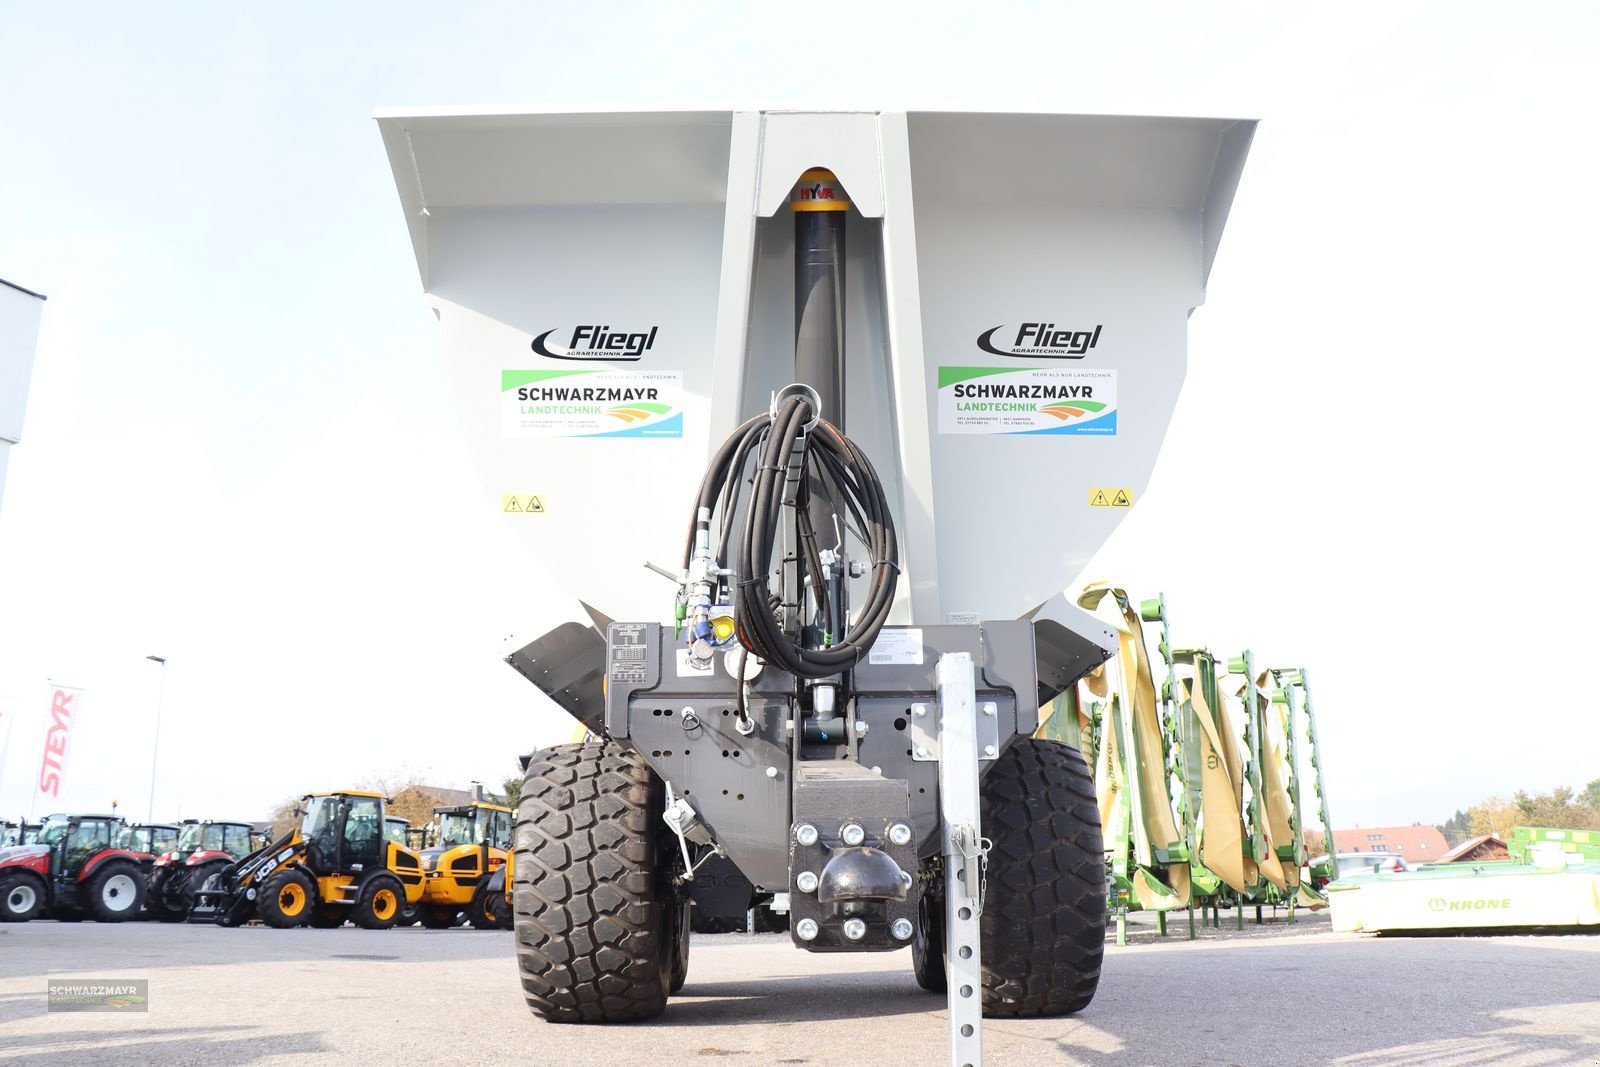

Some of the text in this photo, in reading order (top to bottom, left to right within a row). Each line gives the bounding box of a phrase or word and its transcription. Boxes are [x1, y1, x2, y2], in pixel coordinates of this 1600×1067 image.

[801, 184, 835, 199] HYVA
[569, 325, 658, 356] Fliegl
[1015, 323, 1102, 354] Fliegl
[518, 388, 658, 401] SCHWARZMAYR
[954, 384, 1093, 399] SCHWARZMAYR
[520, 406, 602, 415] LANDTECHNIK
[957, 402, 1037, 411] LANDTECHNIK
[40, 690, 73, 798] STEYR
[255, 858, 278, 882] JCB
[1449, 898, 1511, 911] KRONE
